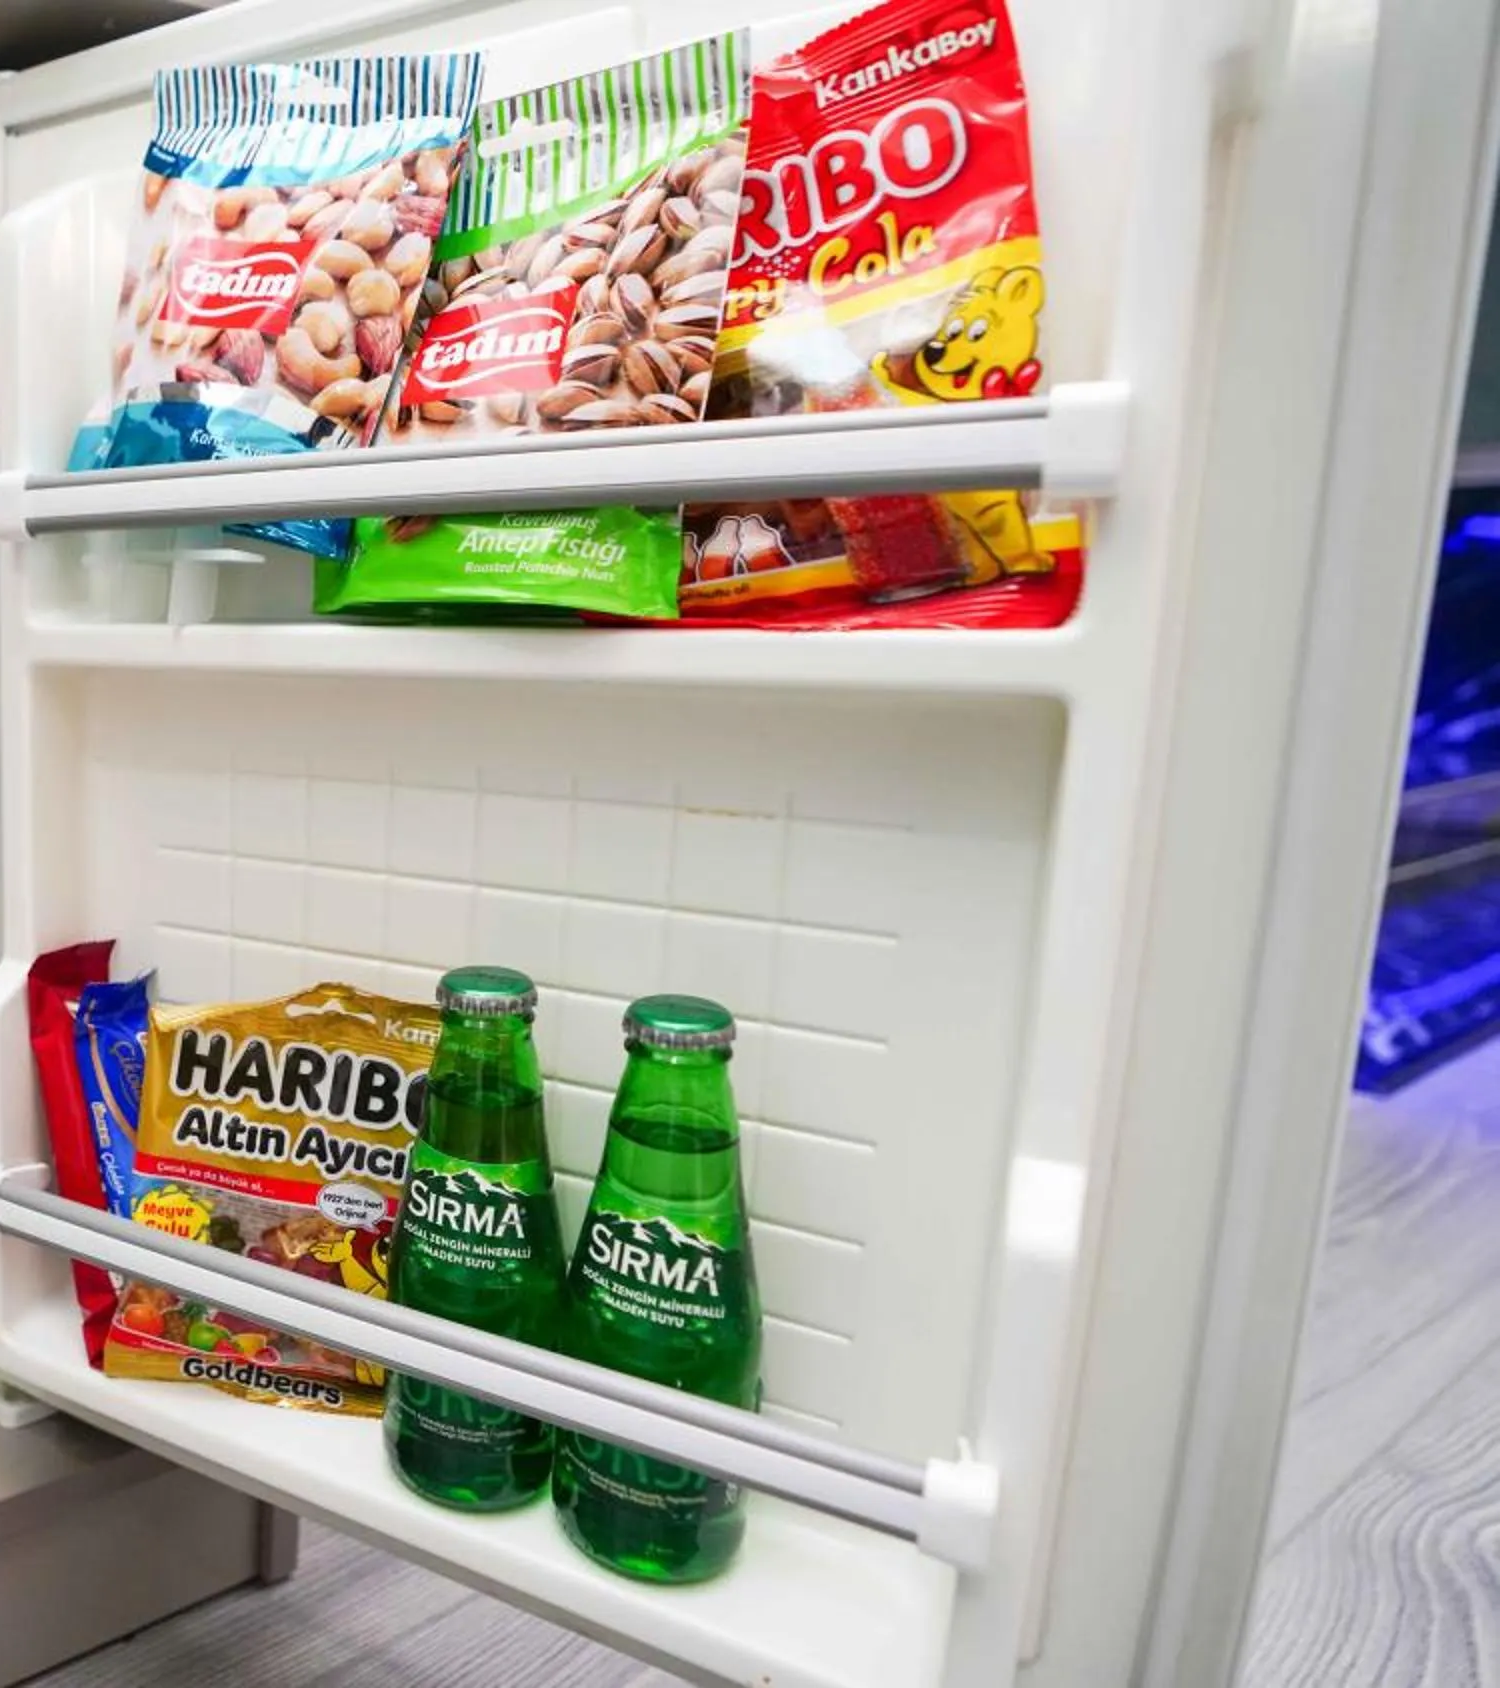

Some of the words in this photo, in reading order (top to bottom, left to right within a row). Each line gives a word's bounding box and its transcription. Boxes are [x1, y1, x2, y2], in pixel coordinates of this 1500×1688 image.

[808, 212, 938, 297] Cola
[180, 264, 297, 299] tadım
[421, 326, 564, 370] tadım
[177, 1106, 284, 1158] Altın
[143, 1202, 195, 1219] Meyve
[465, 1257, 497, 1270] SUYU
[650, 1311, 686, 1328] SUYU
[183, 1357, 342, 1405] Goldbears
